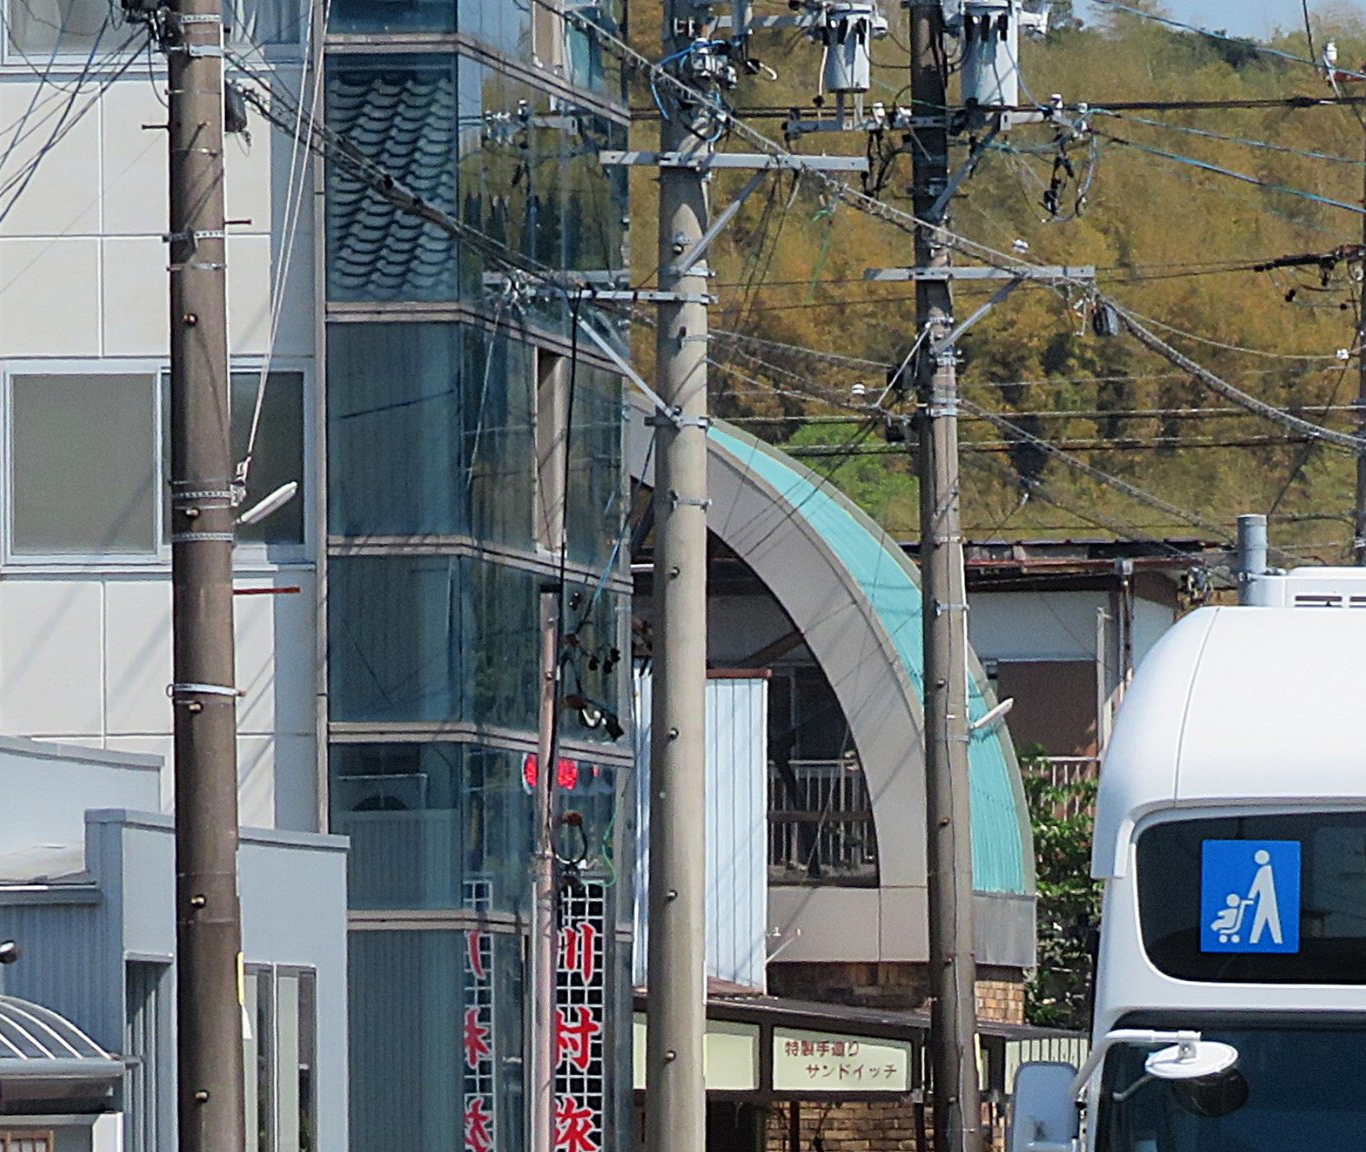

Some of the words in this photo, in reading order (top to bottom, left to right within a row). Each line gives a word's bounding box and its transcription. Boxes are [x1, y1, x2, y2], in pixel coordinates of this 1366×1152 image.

[805, 1063, 898, 1081] サンドイッチ
